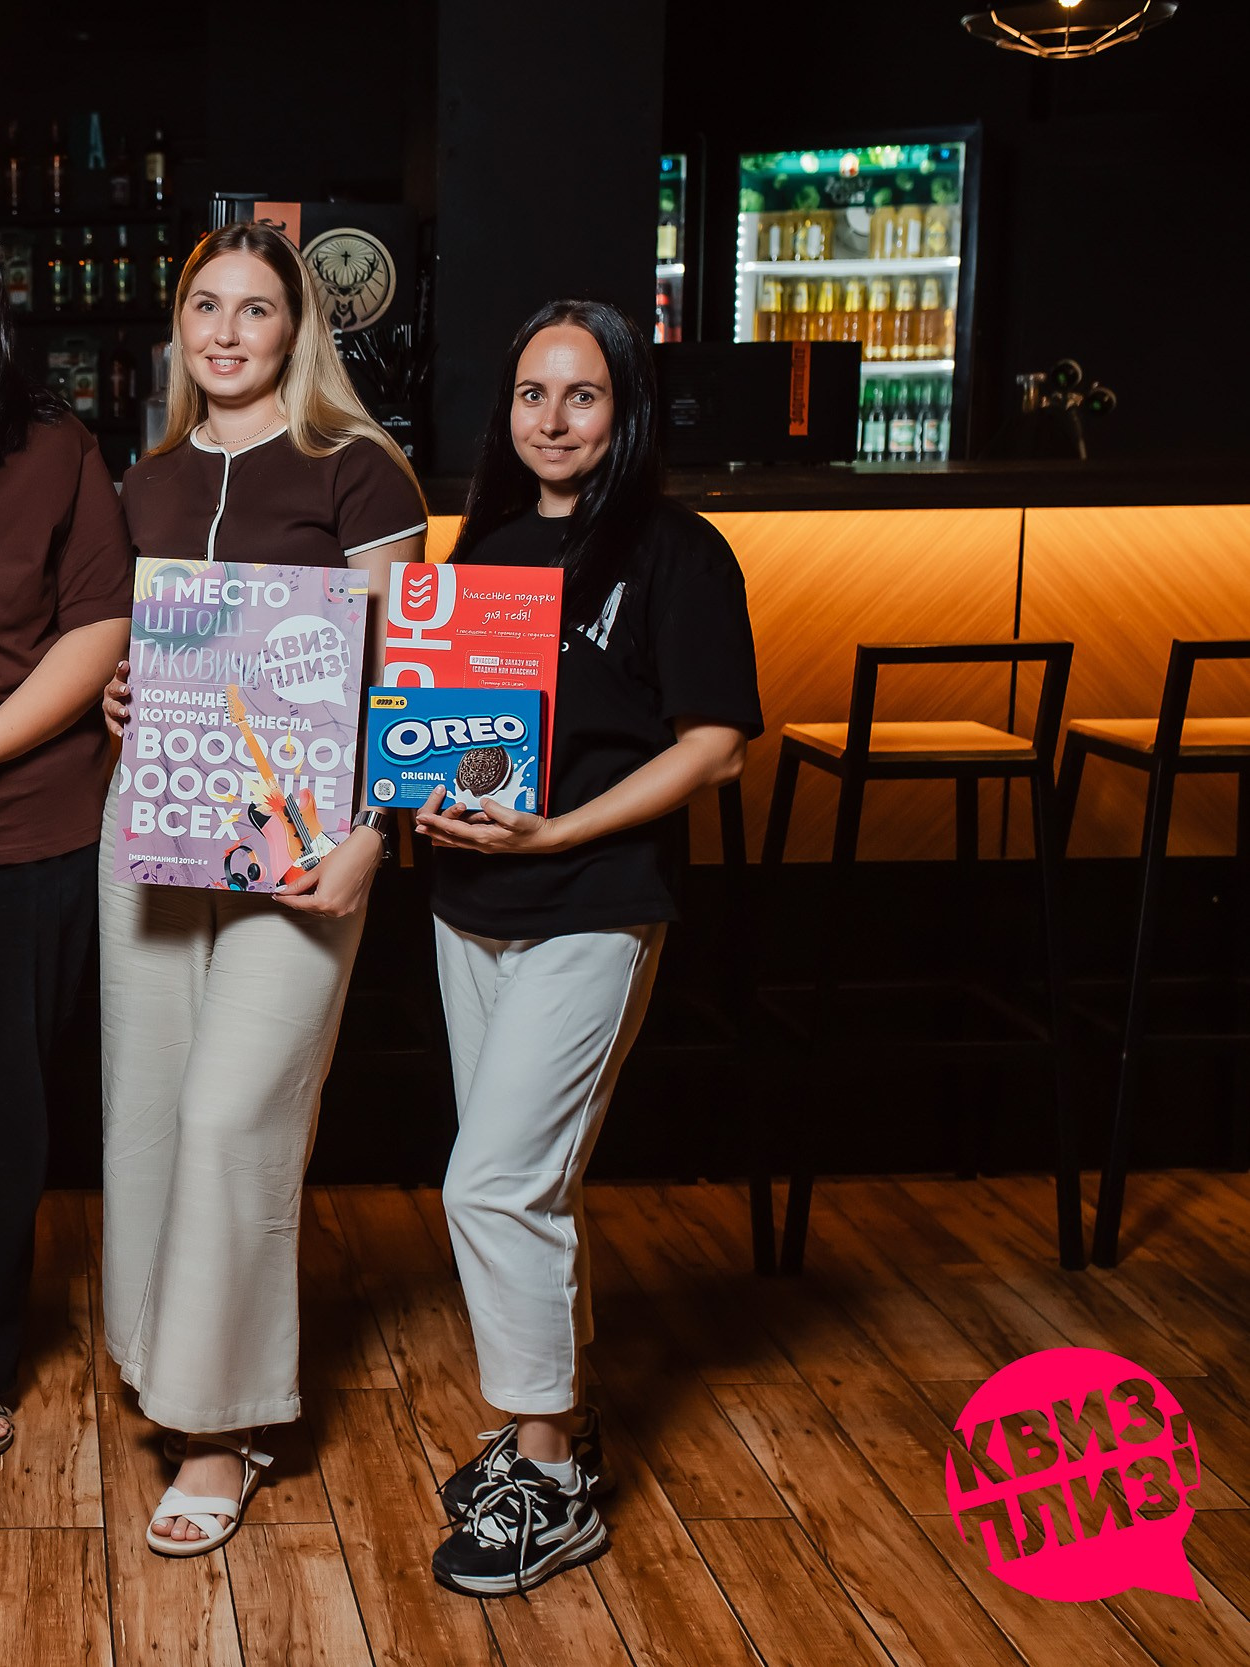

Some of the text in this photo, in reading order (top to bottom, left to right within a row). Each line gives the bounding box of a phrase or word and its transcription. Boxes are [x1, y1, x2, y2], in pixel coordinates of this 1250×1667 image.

[152, 575, 290, 608] 1 МЕСТО
[462, 587, 556, 607] Классные подарки
[482, 609, 531, 624] для тебя!
[140, 688, 229, 708] КОМАНДЕ
[138, 708, 313, 731] КОТОРАЯ РЗНЕСЛА
[386, 715, 525, 757] OREO
[401, 771, 446, 781] ORIGINAL
[131, 801, 242, 840] ВСЕХ
[128, 853, 178, 864] [МЕЛОМАНИЯ]
